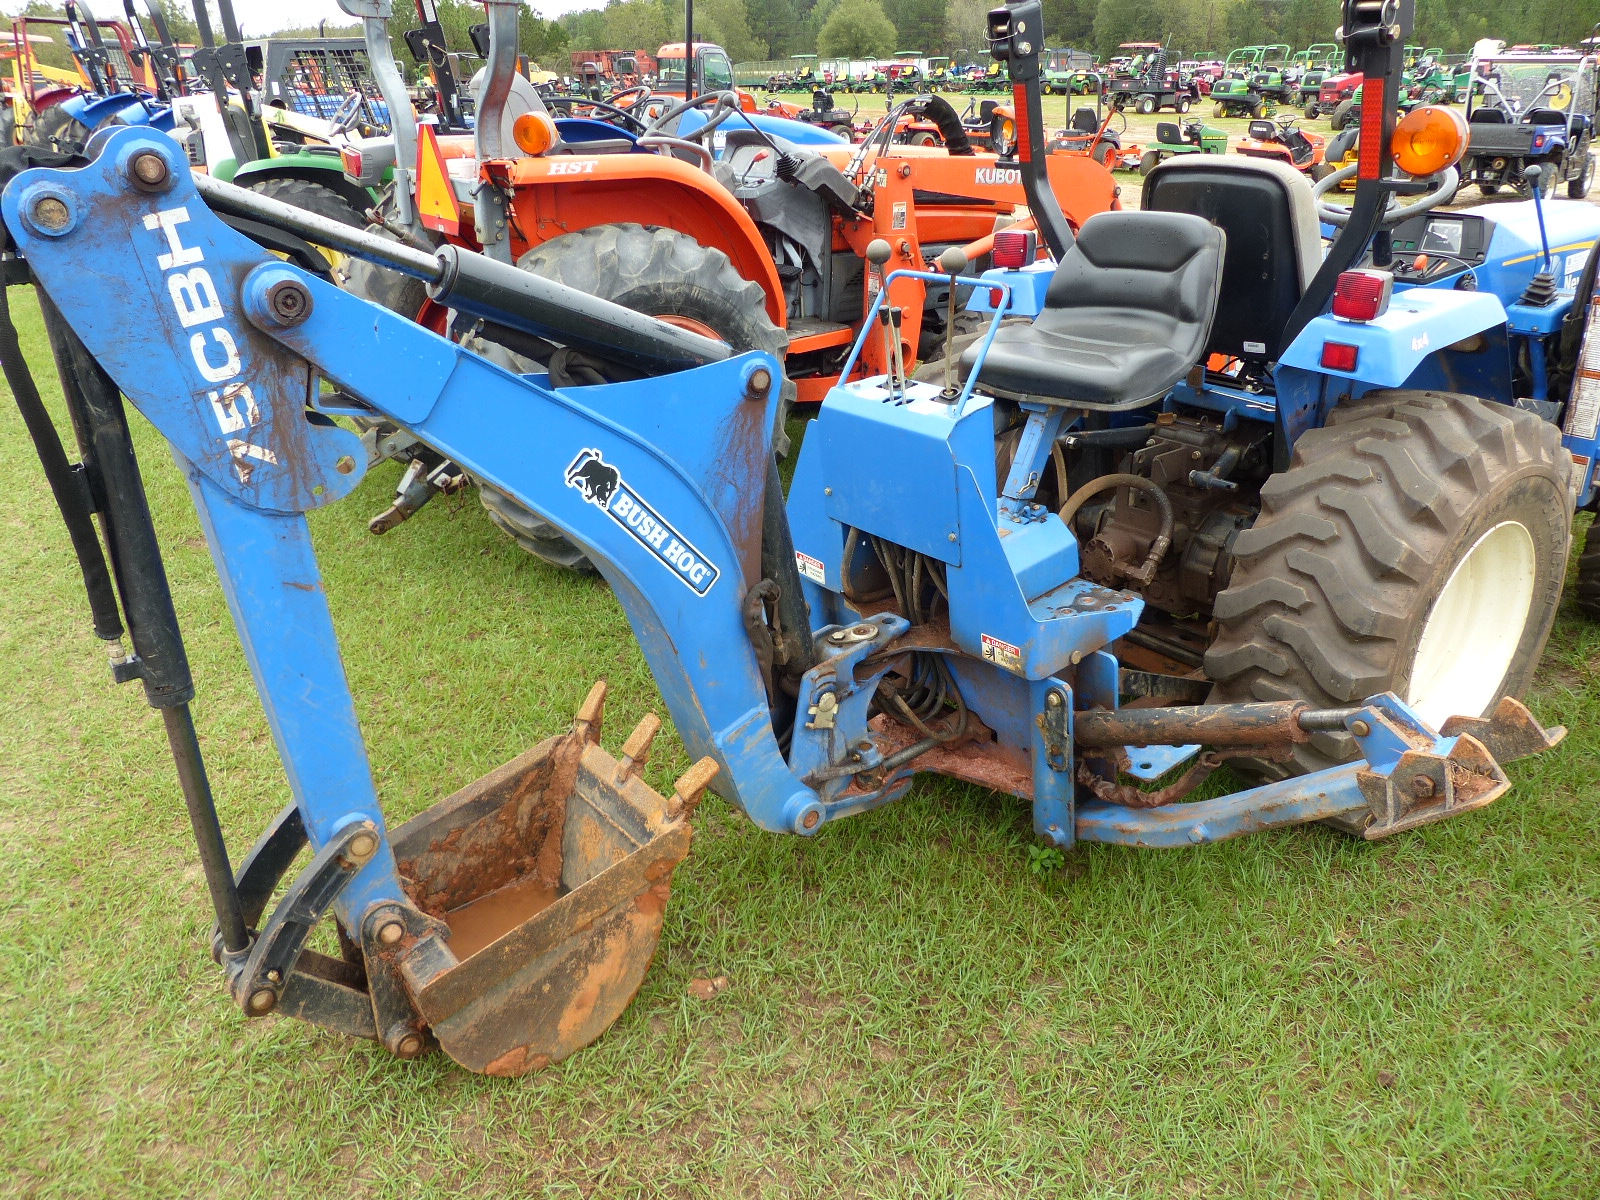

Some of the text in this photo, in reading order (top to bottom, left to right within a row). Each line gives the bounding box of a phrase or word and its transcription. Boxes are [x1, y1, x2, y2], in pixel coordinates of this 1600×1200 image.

[547, 160, 598, 175] HST
[975, 167, 1023, 185] KUBOT
[612, 493, 707, 585] BUSH HOG
[991, 639, 1016, 655] DANGER
